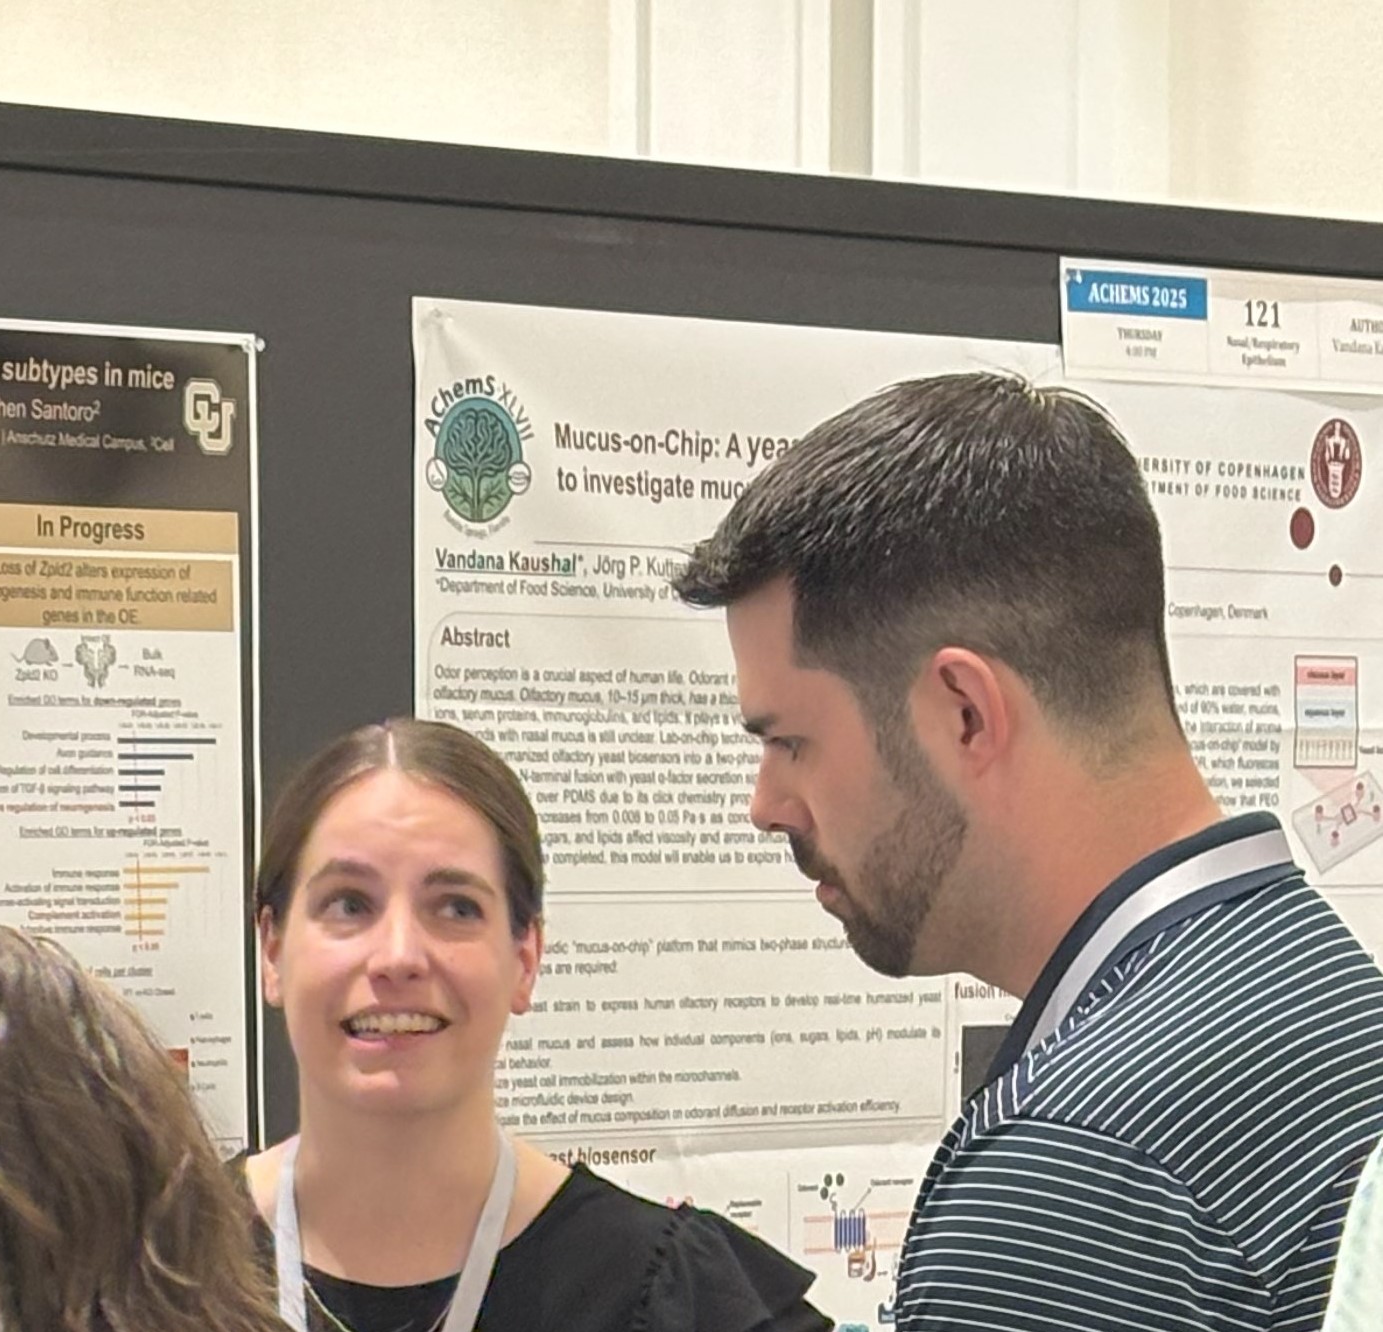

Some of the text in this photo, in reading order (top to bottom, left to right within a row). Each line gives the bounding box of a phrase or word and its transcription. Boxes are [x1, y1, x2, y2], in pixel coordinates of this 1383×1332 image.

[1088, 282, 1187, 309] ACHEMS 2025
[1244, 299, 1280, 329] 121
[1116, 326, 1163, 342] THURSDAY
[1350, 318, 1383, 334] AUTH
[1241, 353, 1287, 369] Epithelium
[1, 356, 99, 391] subtypes
[104, 361, 123, 387] in
[127, 363, 175, 390] mice
[424, 374, 535, 441] AChemS XLVII
[555, 422, 719, 463] Mucus-on-Chip:
[725, 432, 742, 460] A
[1195, 460, 1212, 476] OF
[1217, 461, 1305, 482] COPENHAGEN
[558, 466, 577, 492] to
[584, 465, 694, 504] investigate
[1194, 482, 1210, 497] OF
[1215, 484, 1247, 500] FOOD
[1252, 485, 1301, 503] SCIENCE
[37, 513, 145, 546] In Progress
[435, 547, 505, 570] Vandana
[440, 625, 511, 649] Abstract
[954, 981, 995, 1000] fusion
[577, 1147, 657, 1165] biosensor
